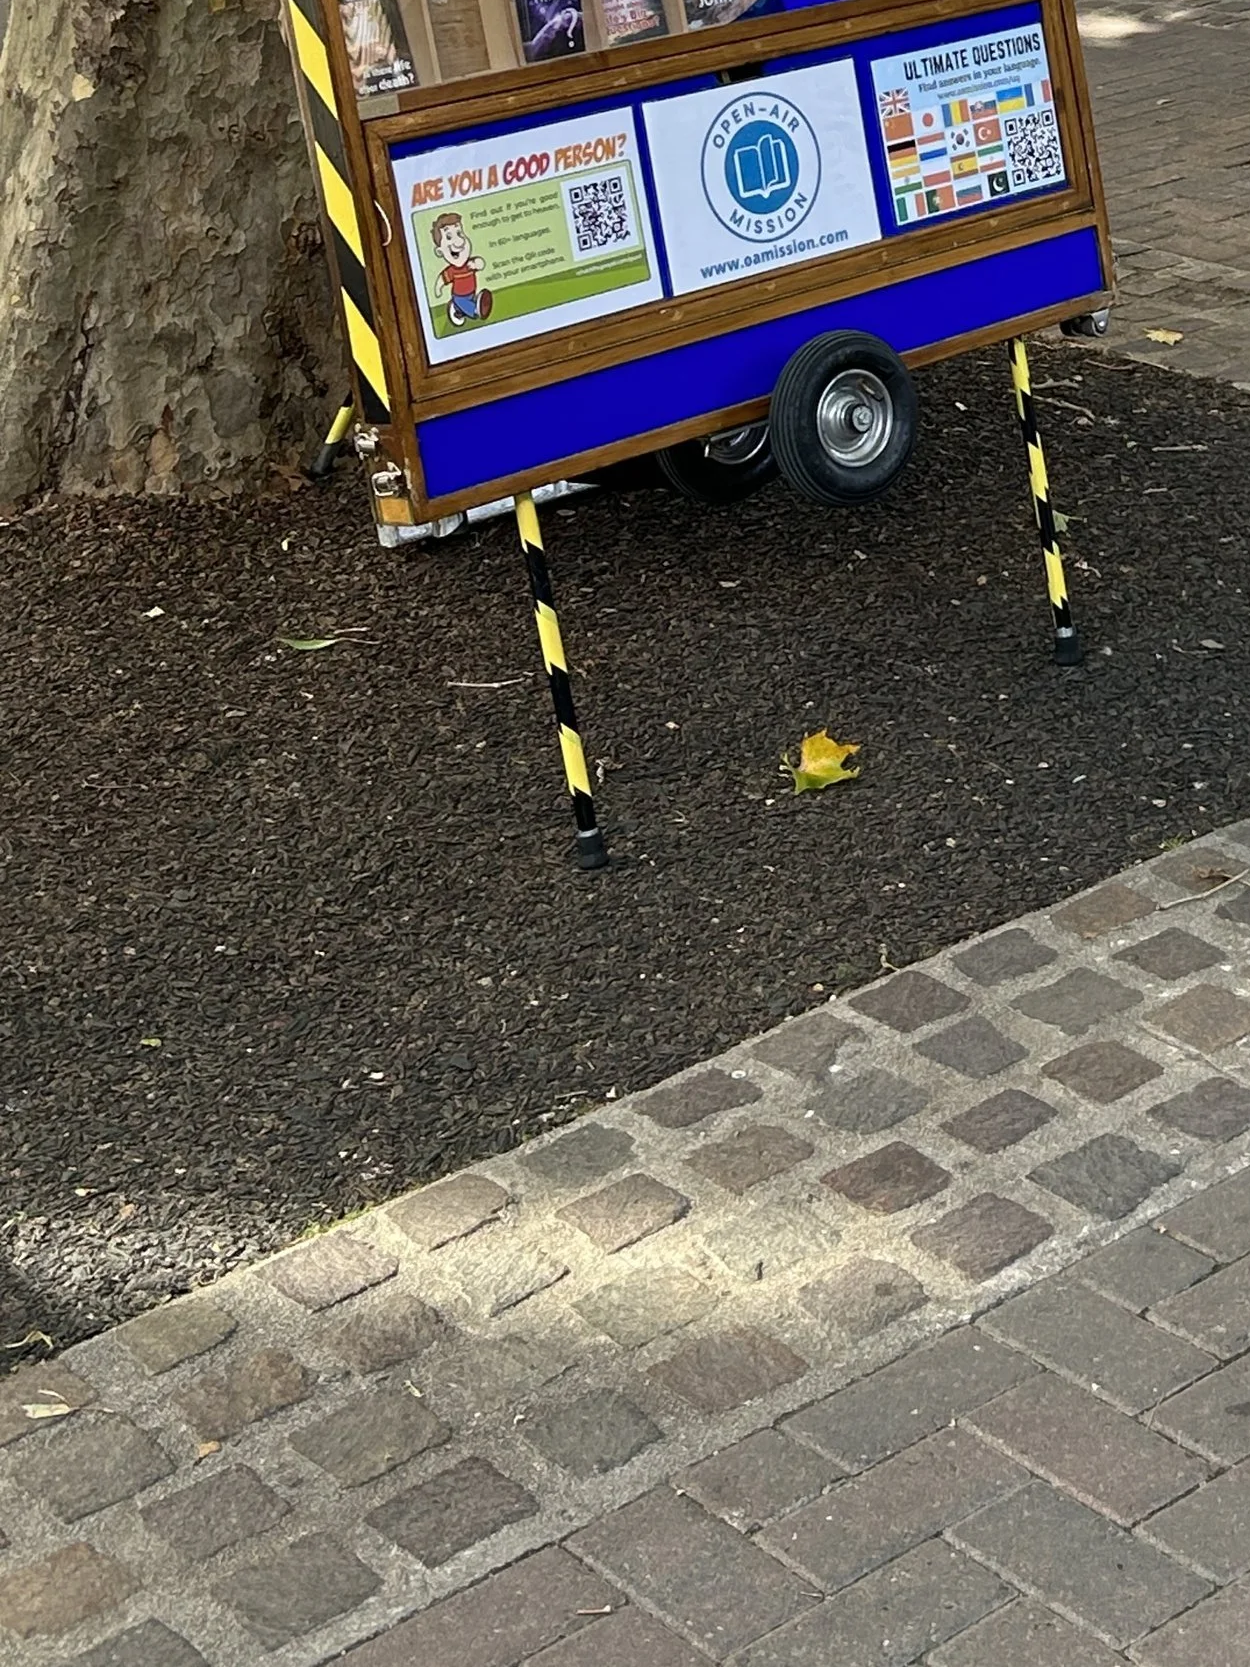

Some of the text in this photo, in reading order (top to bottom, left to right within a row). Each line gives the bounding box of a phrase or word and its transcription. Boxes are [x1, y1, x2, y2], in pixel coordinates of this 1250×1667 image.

[903, 32, 1041, 81] ULTIMATE QUESTIONS
[378, 72, 414, 91] death?
[918, 79, 937, 94] Find
[939, 74, 972, 88] answers
[973, 70, 982, 81] in
[983, 65, 1002, 80] your
[713, 101, 801, 150] OPEN-AIR
[411, 133, 627, 209] ARE YOU A GOOD PERSON?
[470, 209, 488, 220] Find
[490, 206, 504, 215] out
[514, 197, 537, 210] you're
[539, 192, 559, 204] good
[729, 192, 809, 235] MISSION
[472, 218, 501, 230] enough
[510, 212, 524, 223] get
[492, 247, 556, 270] Scan the QR code
[700, 228, 849, 279] www.oamission.com
[486, 272, 502, 282] with
[502, 268, 520, 280] your
